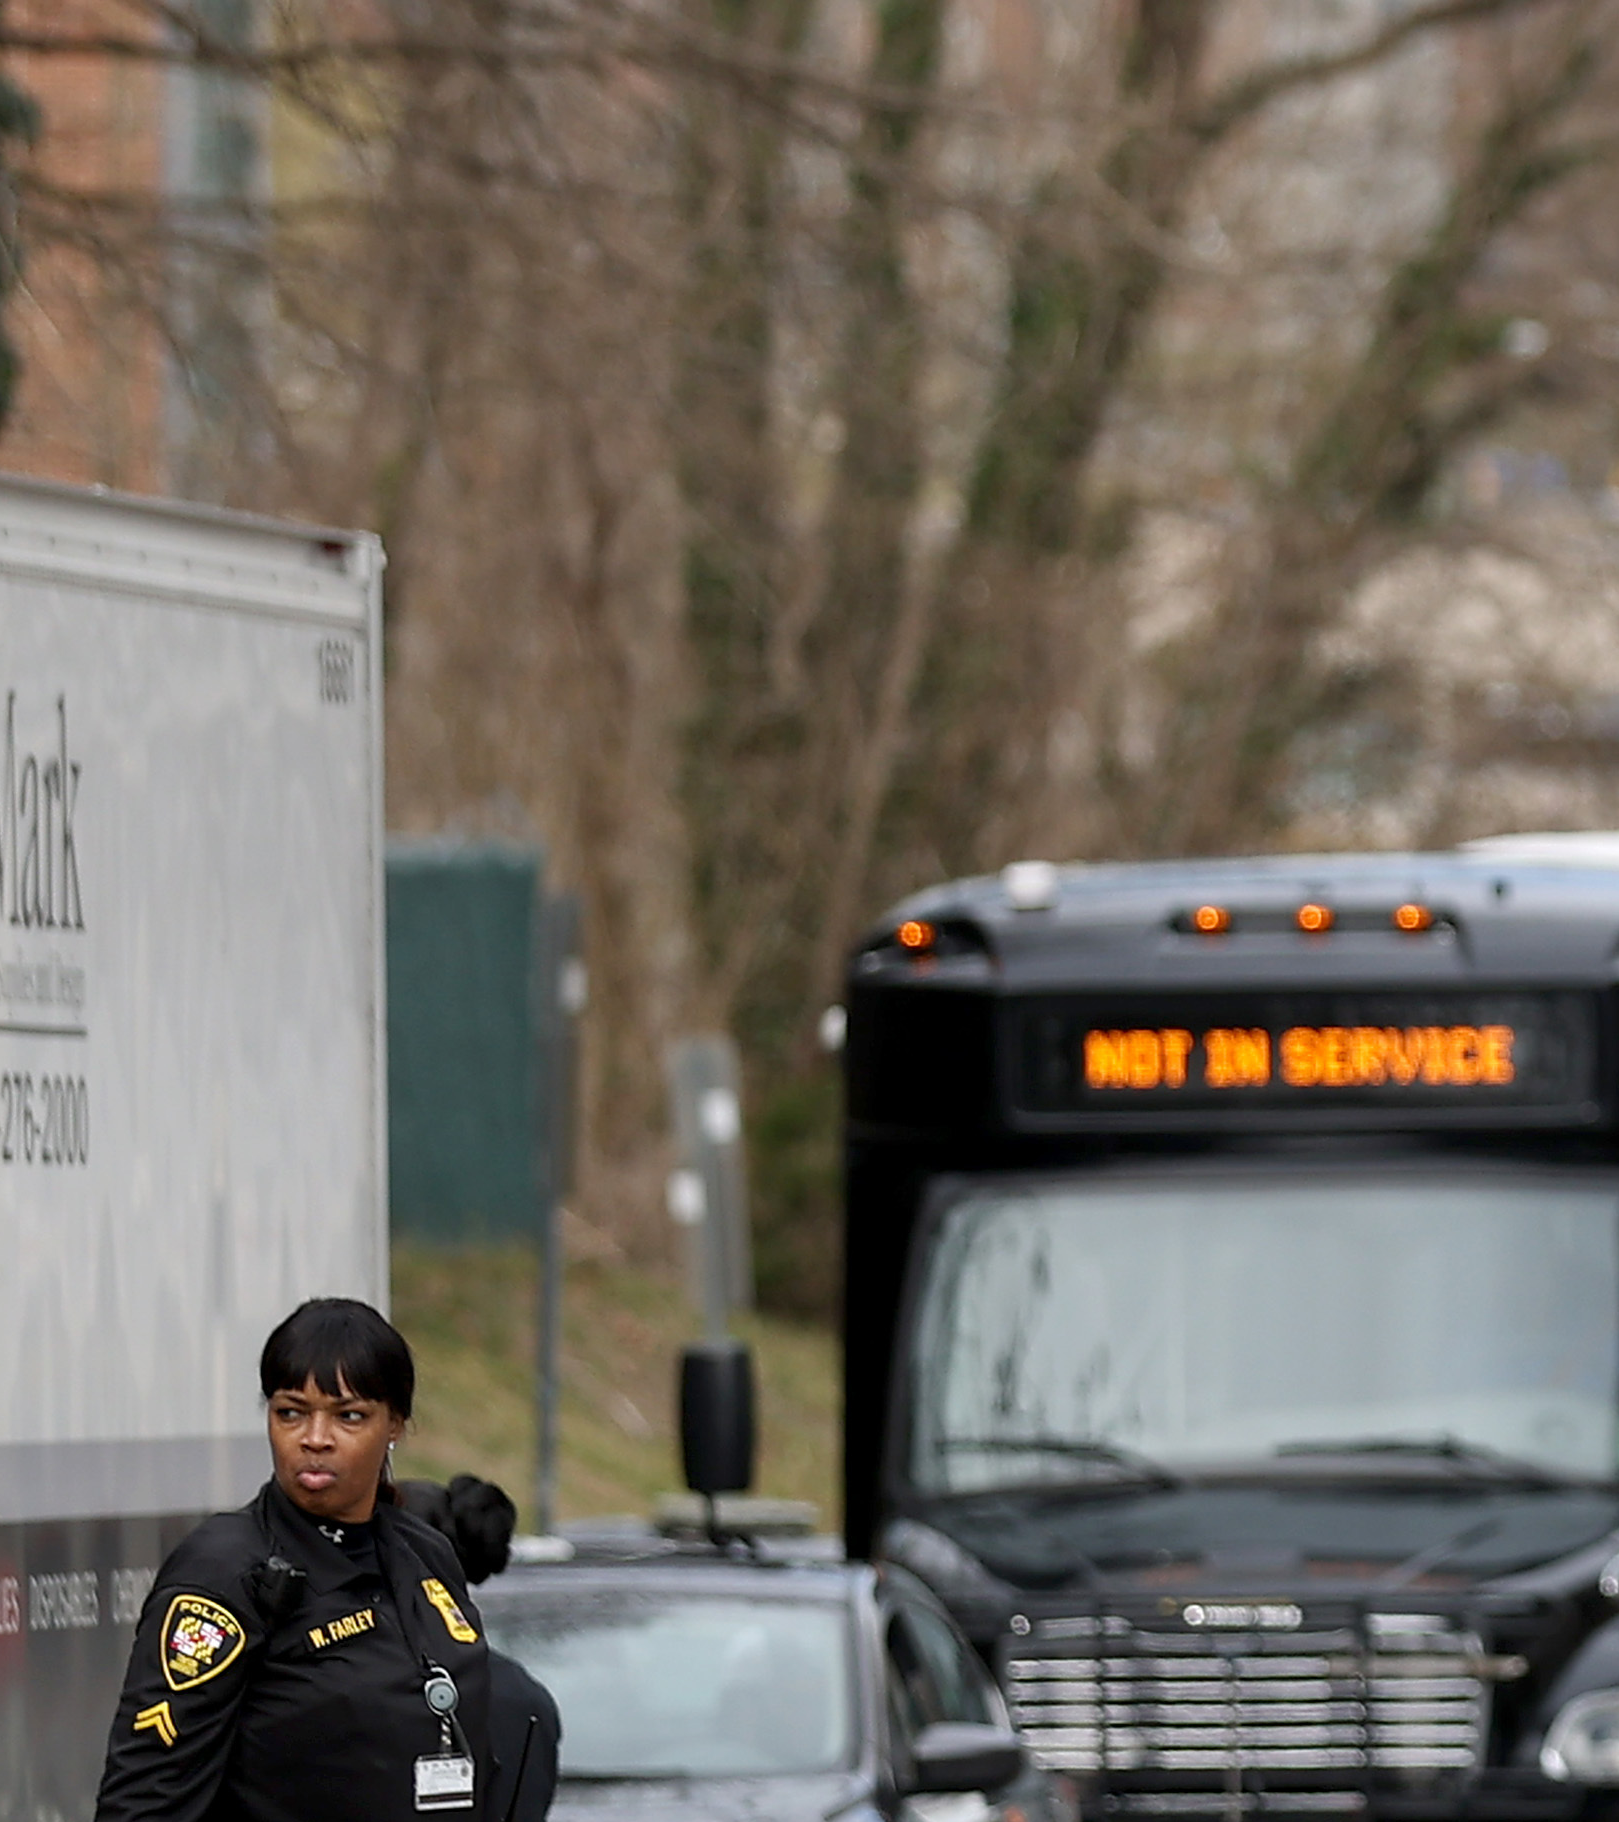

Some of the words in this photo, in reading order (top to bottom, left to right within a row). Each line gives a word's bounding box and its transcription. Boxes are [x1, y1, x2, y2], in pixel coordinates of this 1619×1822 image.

[1084, 1028, 1194, 1089] NOT
[1203, 1026, 1271, 1088] IN
[1281, 1024, 1516, 1087] SERVICE
[179, 1601, 239, 1638] POLICE
[308, 1626, 332, 1649] W.
[327, 1607, 377, 1643] FARLEY
